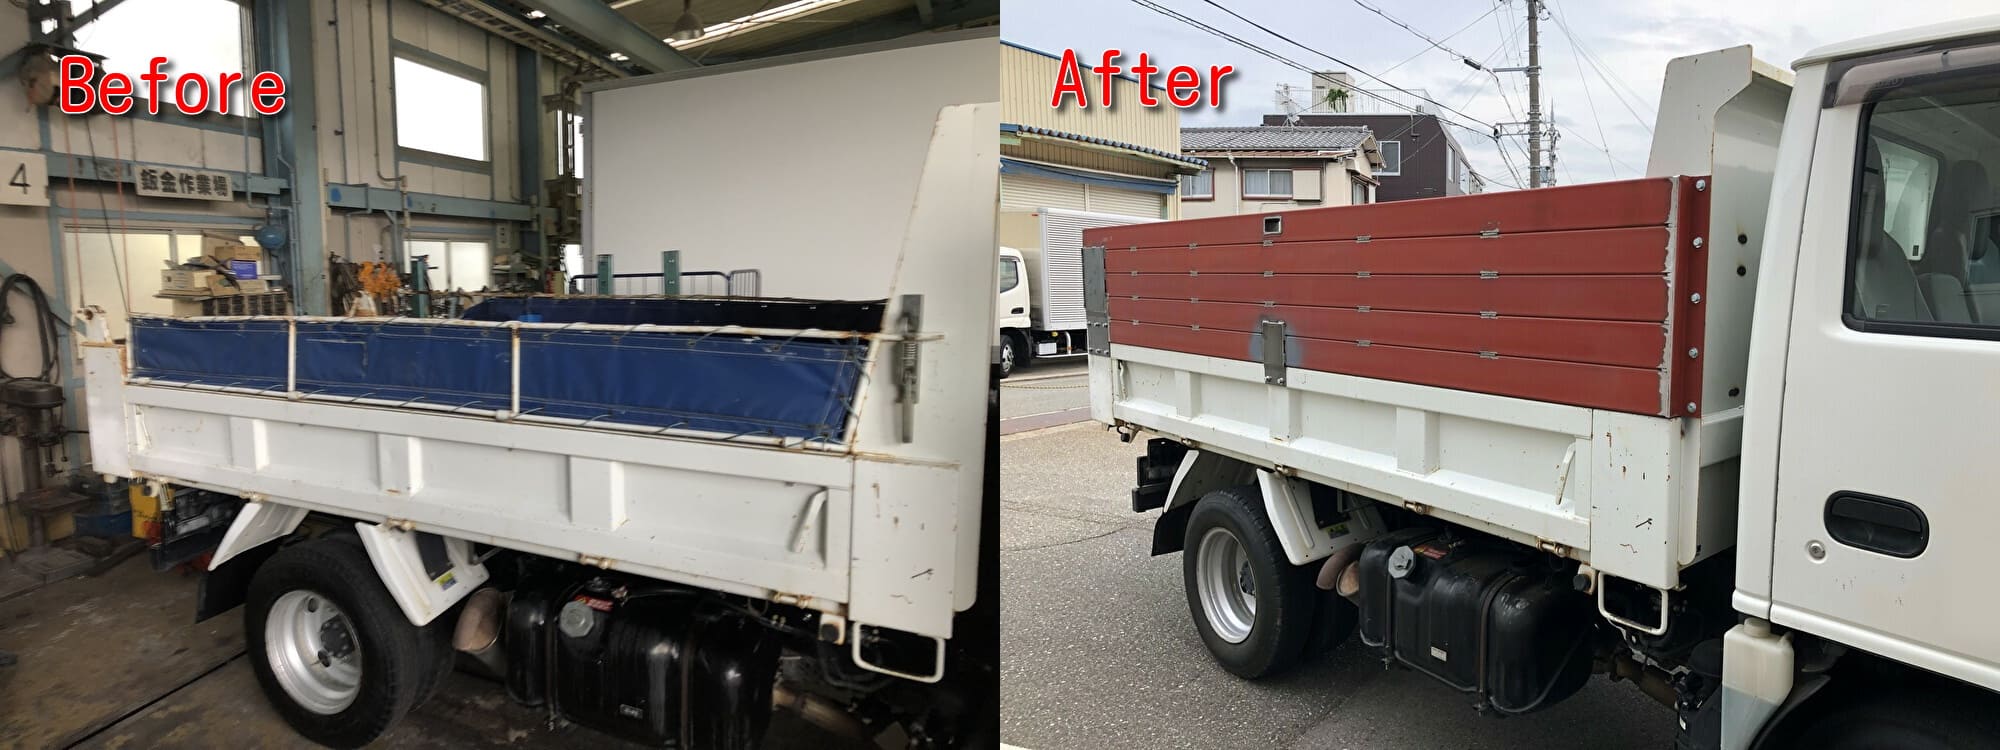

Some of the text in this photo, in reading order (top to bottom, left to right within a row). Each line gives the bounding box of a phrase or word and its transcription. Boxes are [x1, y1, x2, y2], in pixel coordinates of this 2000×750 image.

[8, 162, 32, 195] 4
[140, 168, 228, 197] 鈑金作業場
